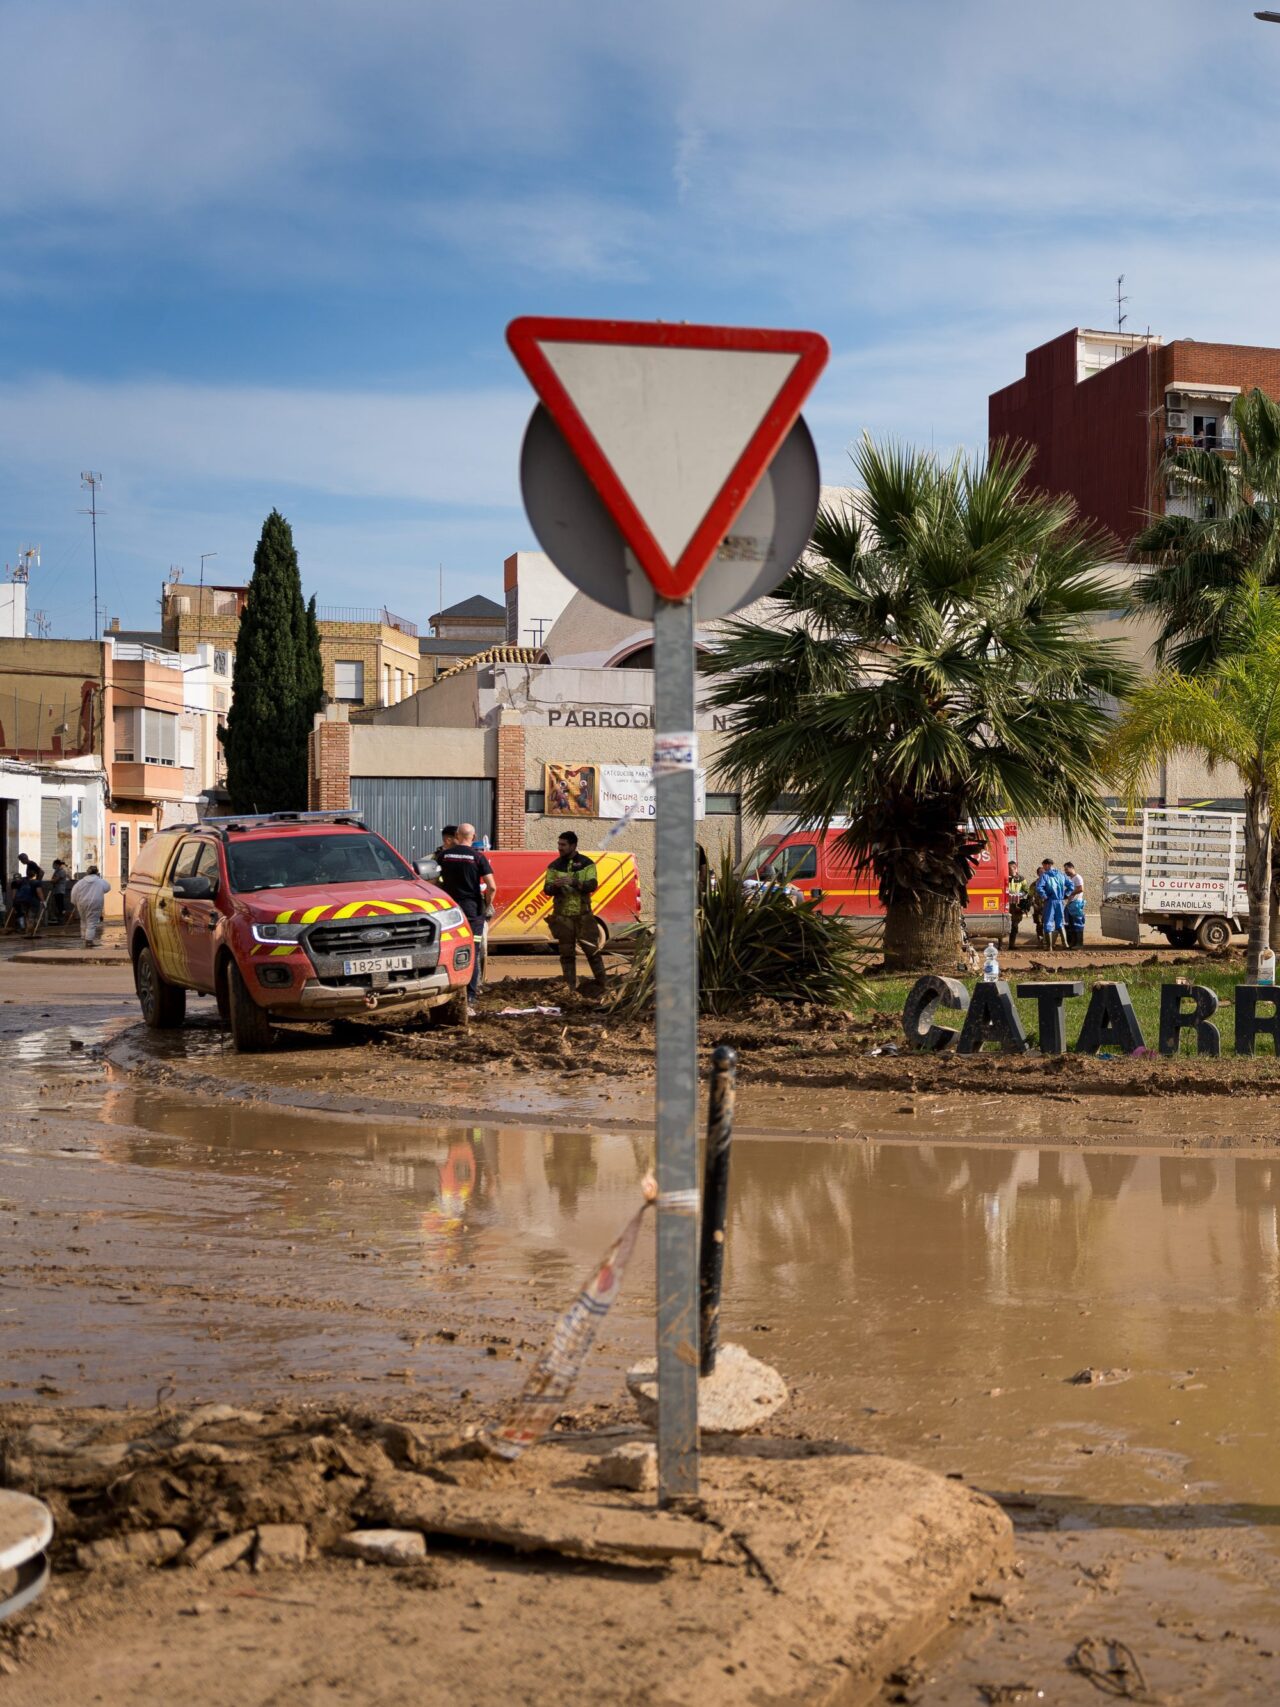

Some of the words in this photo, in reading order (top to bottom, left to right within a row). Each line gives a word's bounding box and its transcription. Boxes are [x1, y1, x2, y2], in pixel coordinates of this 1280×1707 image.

[1152, 879, 1165, 888] Lo
[1170, 880, 1225, 890] curvamos
[1160, 900, 1212, 909] BARANDILLAS
[353, 959, 382, 973] 1825
